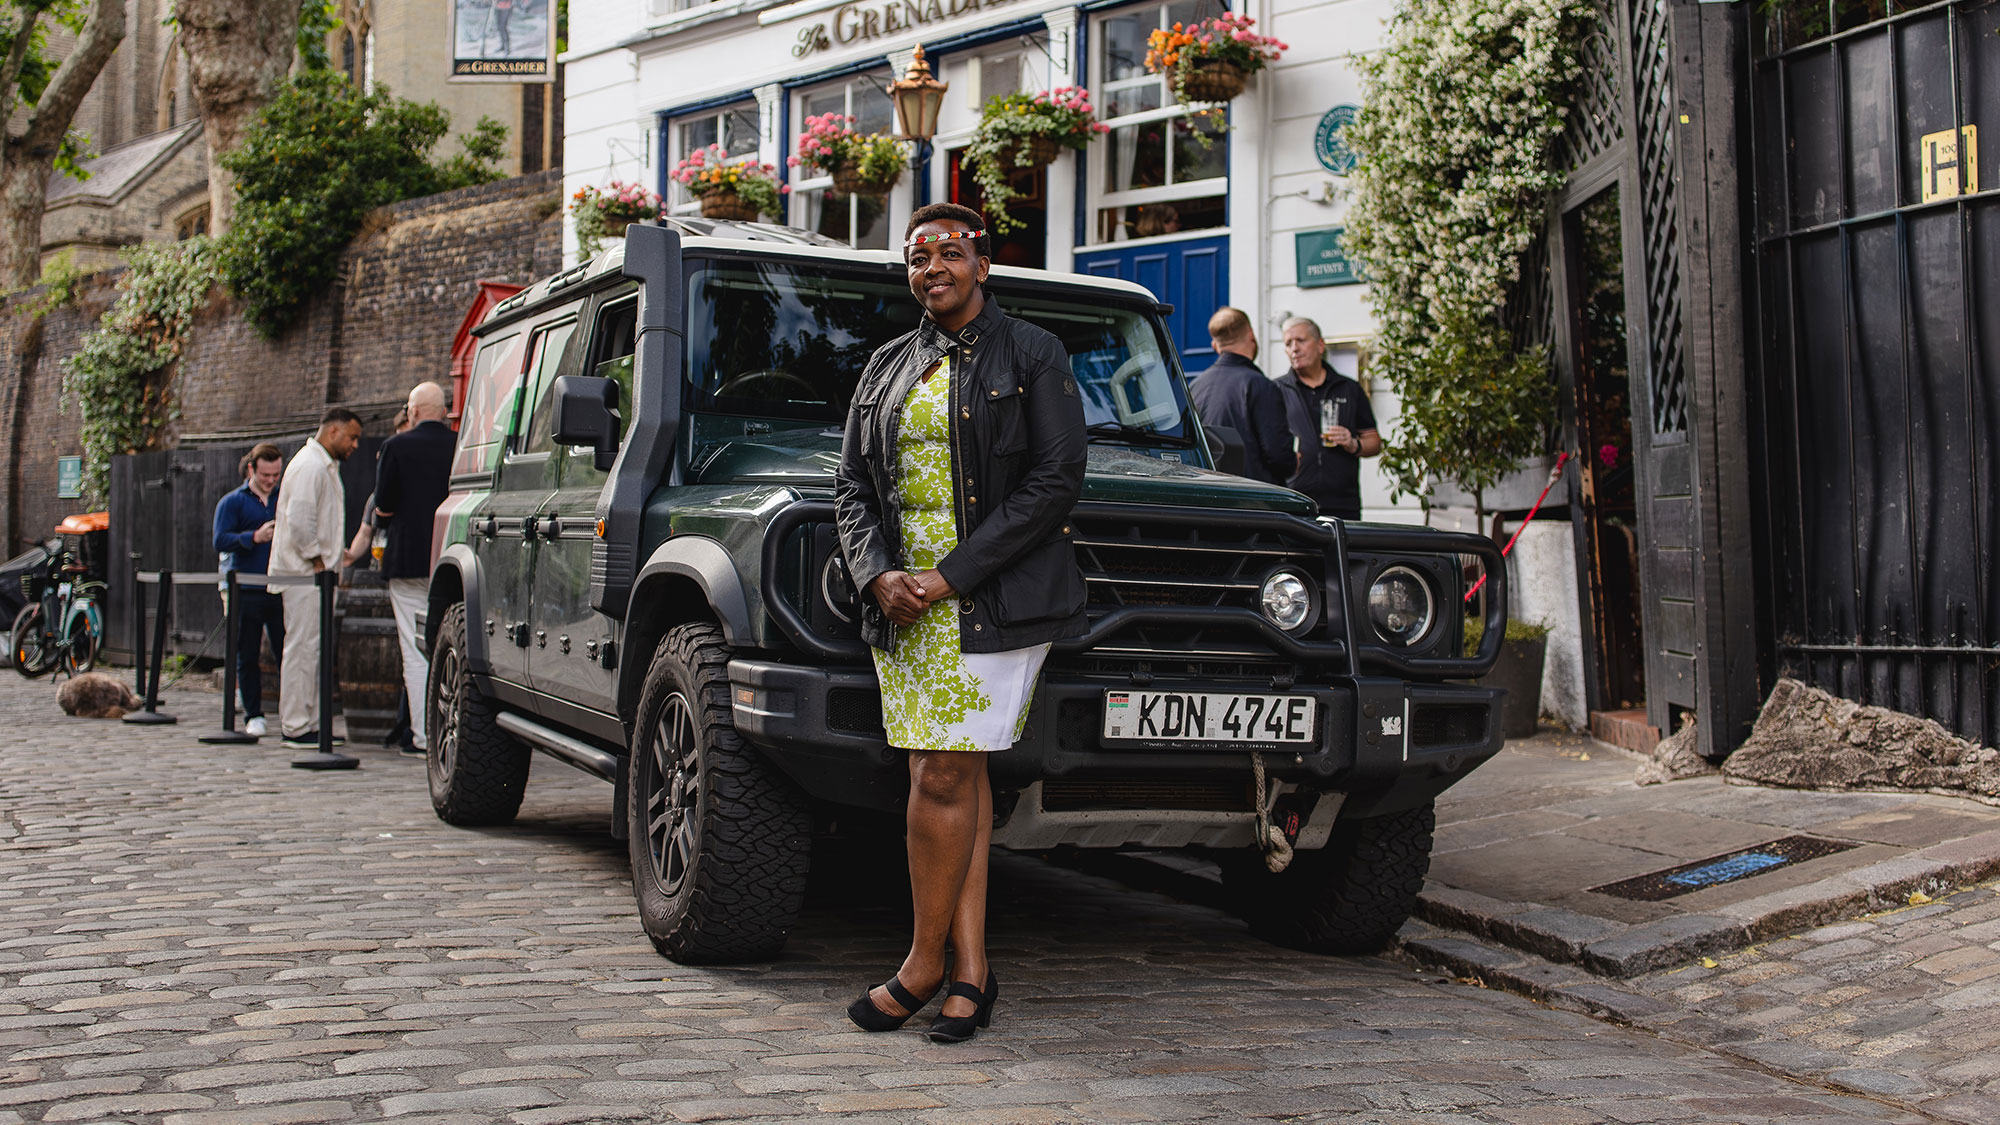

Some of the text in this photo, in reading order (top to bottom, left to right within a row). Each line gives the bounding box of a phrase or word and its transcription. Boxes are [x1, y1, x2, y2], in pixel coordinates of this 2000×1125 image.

[471, 60, 546, 73] GRENADIER
[1306, 261, 1345, 276] PRIVATE
[1138, 694, 1208, 737] KDN
[1222, 697, 1308, 740] 474E
